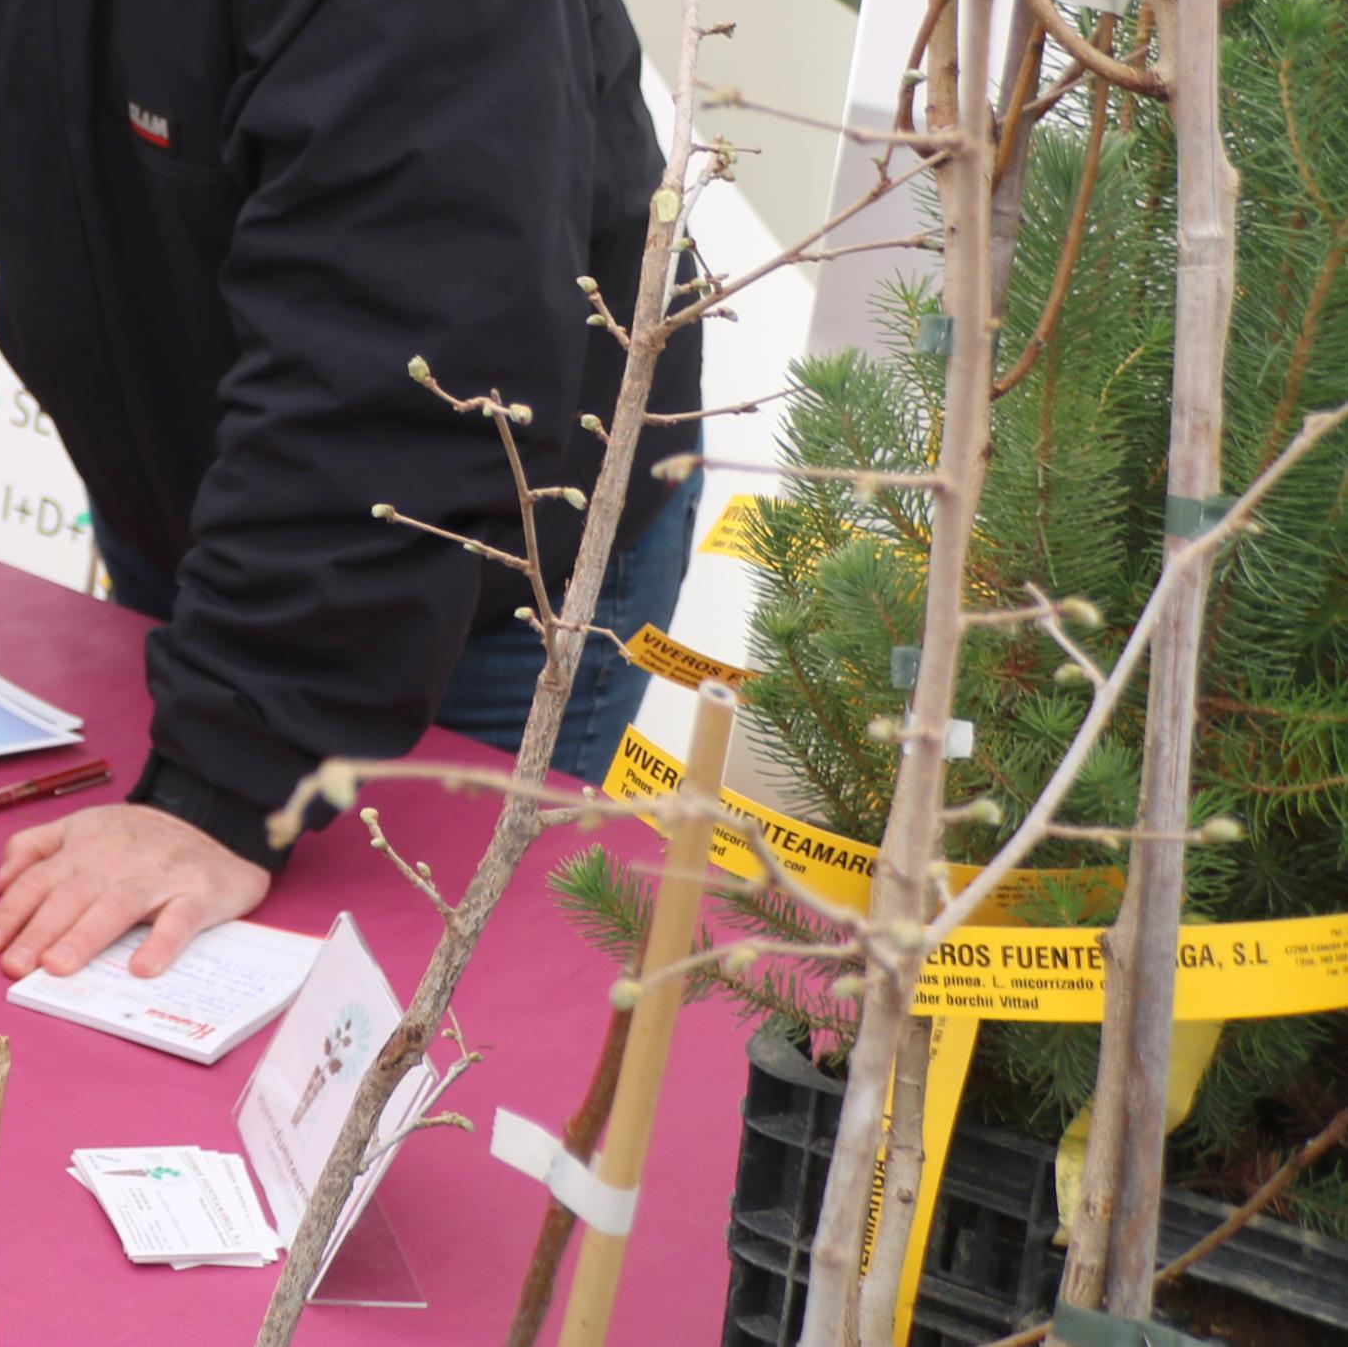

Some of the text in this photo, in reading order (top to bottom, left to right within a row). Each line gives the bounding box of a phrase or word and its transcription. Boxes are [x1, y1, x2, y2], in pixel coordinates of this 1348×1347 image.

[642, 632, 723, 677] VIVEROS
[623, 737, 684, 794] VIVER
[924, 940, 1269, 971] EROS FUENTEGA, S.L
[943, 974, 986, 989] pinea.
[1010, 975, 1095, 991] micorrizado
[946, 992, 995, 1009] borchii
[999, 994, 1040, 1011] Vittad
